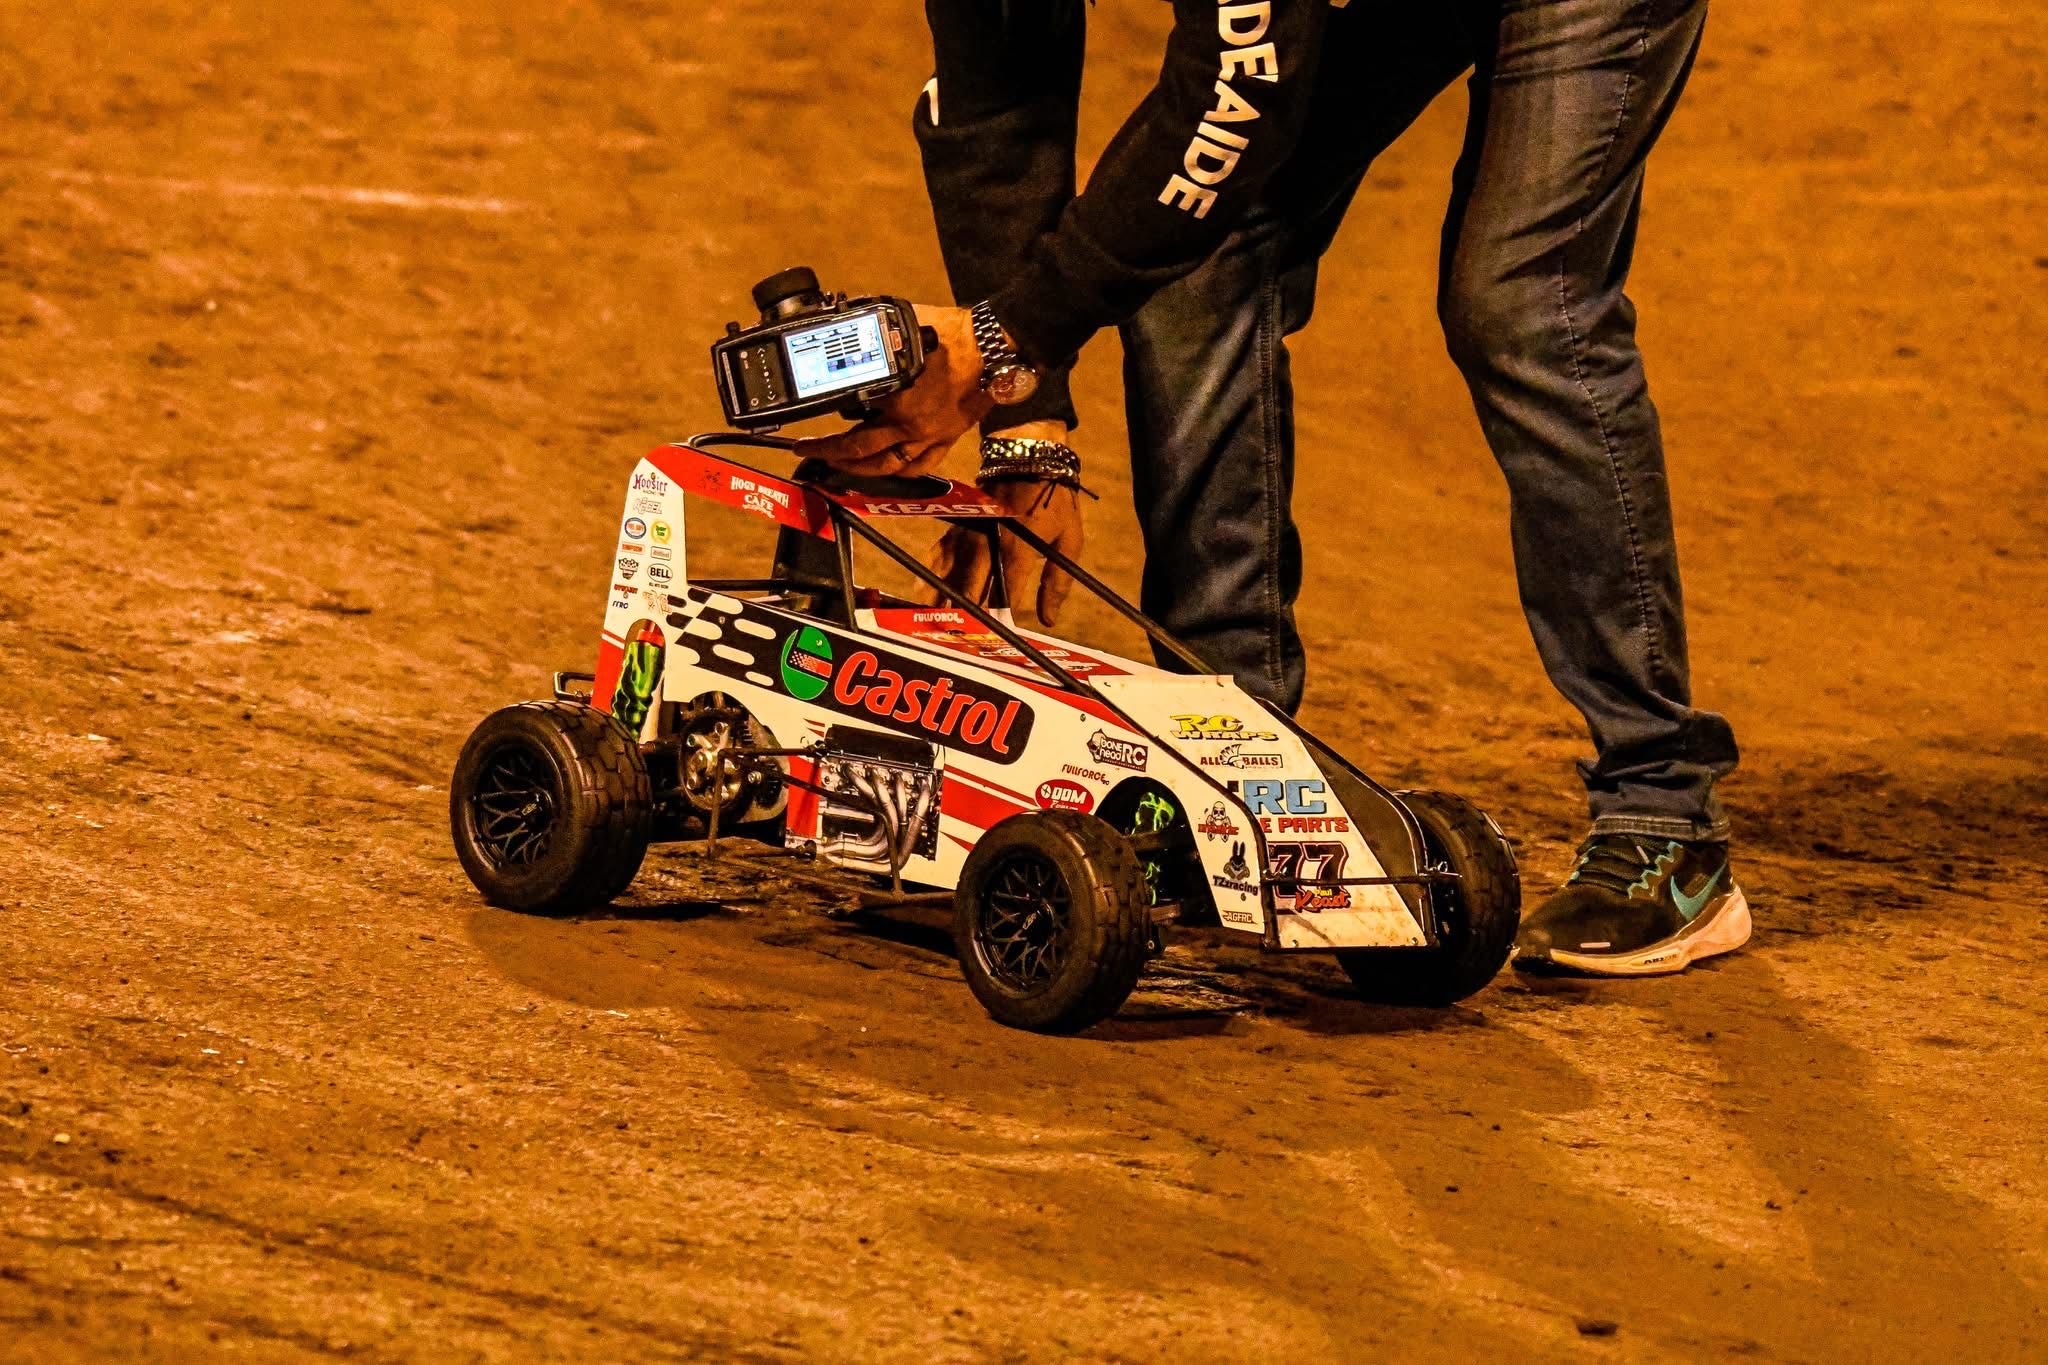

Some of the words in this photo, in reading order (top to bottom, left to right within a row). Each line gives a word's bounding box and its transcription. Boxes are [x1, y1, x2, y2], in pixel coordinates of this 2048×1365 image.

[864, 503, 999, 515] KEAST
[650, 567, 671, 579] BELL
[834, 651, 1021, 754] Castrol
[1170, 714, 1244, 732] RC
[1121, 743, 1146, 766] RC
[1200, 757, 1220, 766] ALL
[1242, 757, 1279, 766] BALLS
[1278, 817, 1349, 833] PARTS
[1267, 841, 1350, 898] 77
[1295, 890, 1351, 913] Keast
